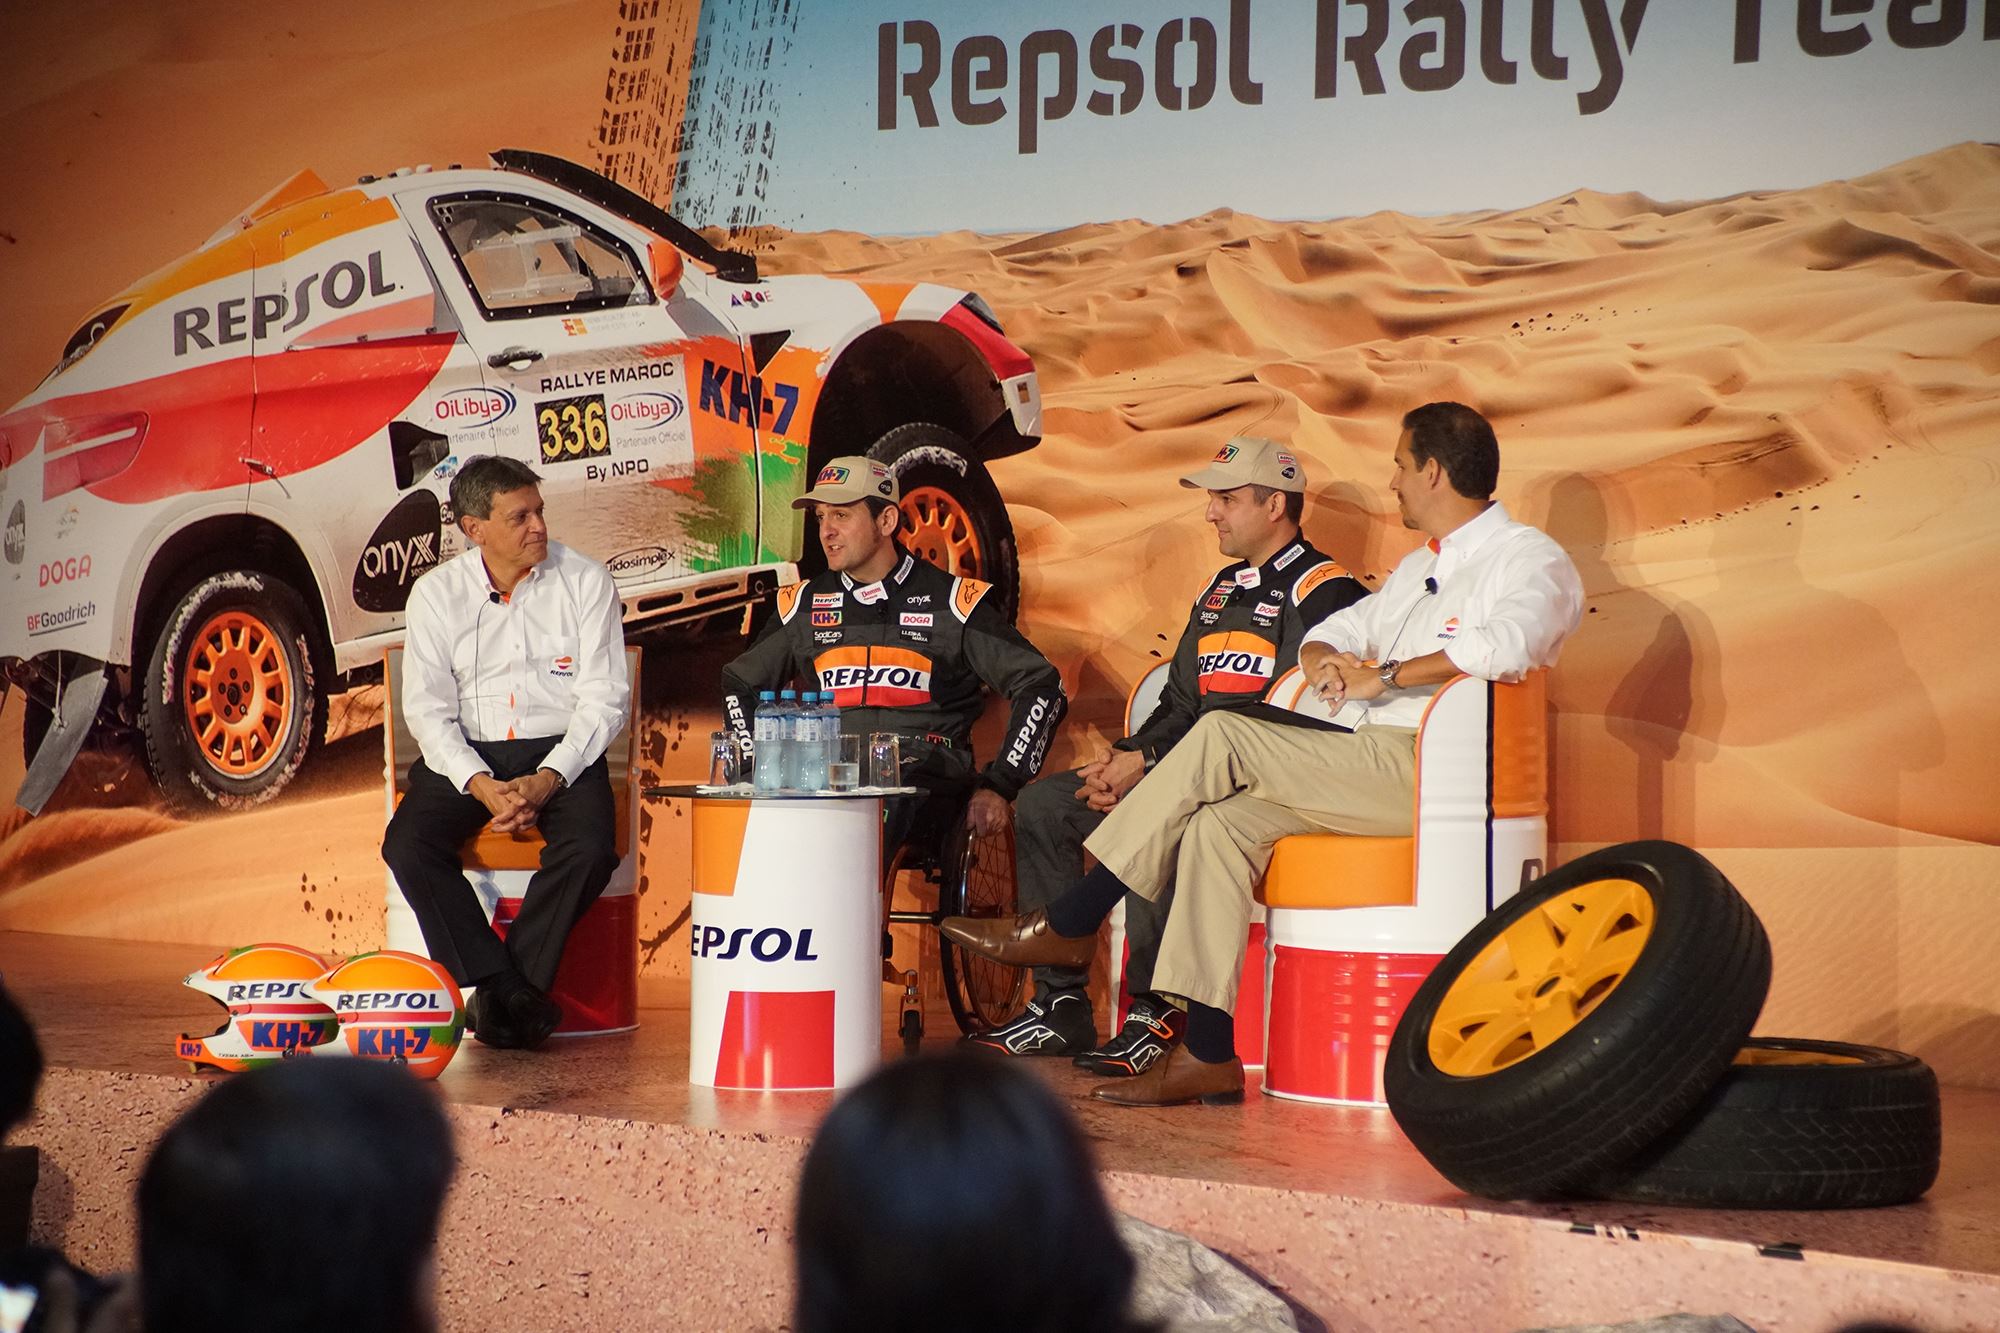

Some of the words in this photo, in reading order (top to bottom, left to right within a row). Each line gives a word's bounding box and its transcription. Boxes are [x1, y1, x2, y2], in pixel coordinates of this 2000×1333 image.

[877, 0, 1263, 154] Repsol
[1314, 0, 1650, 115] Rally
[173, 250, 396, 357] REPSOL
[540, 369, 606, 394] RALLYE
[609, 361, 675, 384] MAROC
[699, 358, 799, 436] KH-7
[539, 401, 608, 458] 336
[586, 464, 607, 482] By
[611, 458, 649, 477] NPO
[39, 554, 92, 588] DOGA
[27, 600, 96, 631] BFGoodrich
[813, 611, 840, 625] KH-7
[903, 616, 931, 625] DOGA
[822, 667, 922, 690] REPSOL
[725, 695, 754, 760] REPSOL
[1006, 696, 1050, 768] REPSOL
[227, 983, 311, 1002] REPS
[337, 992, 440, 1011] REPSOL
[181, 1042, 202, 1057] KH-7
[358, 1028, 431, 1056] KH-7
